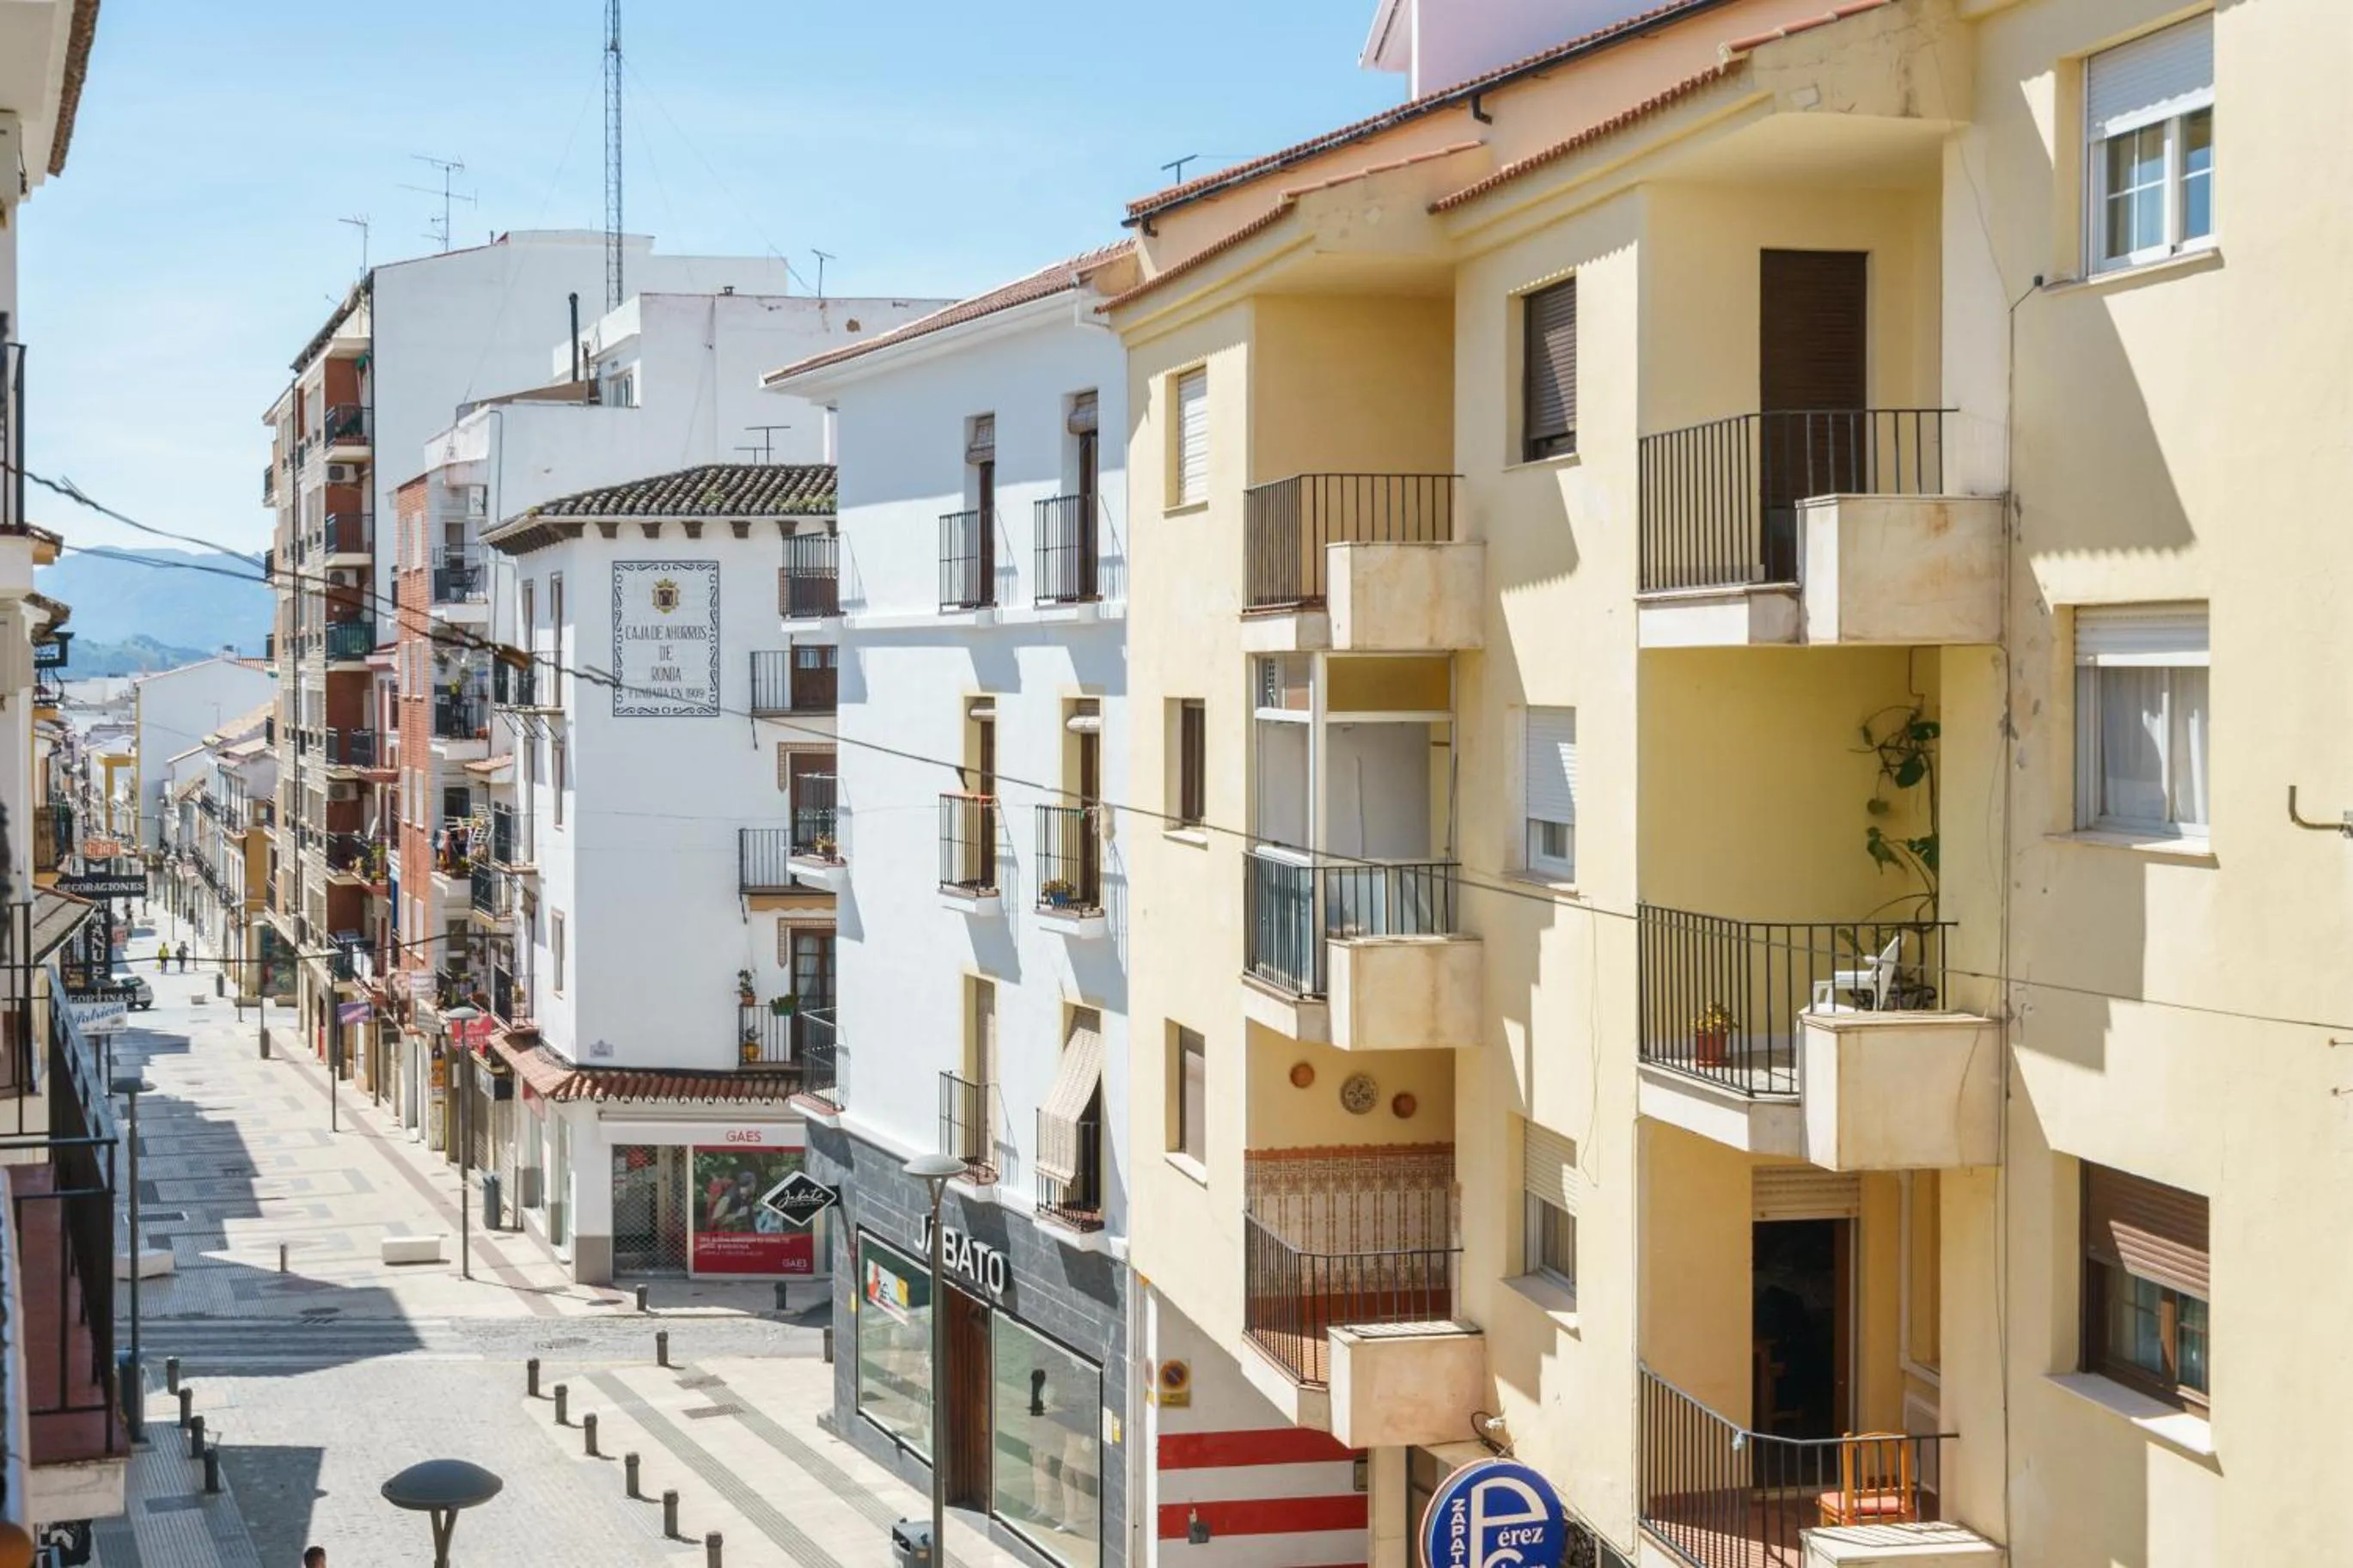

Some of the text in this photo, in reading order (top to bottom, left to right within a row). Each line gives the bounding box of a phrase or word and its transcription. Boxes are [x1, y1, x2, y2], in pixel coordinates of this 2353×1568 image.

[625, 625, 706, 640] CAJA DE AHORROS
[659, 644, 672, 661] DE
[651, 666, 681, 681] RONDA
[725, 1130, 762, 1143] GAES
[782, 1259, 808, 1268] GAES
